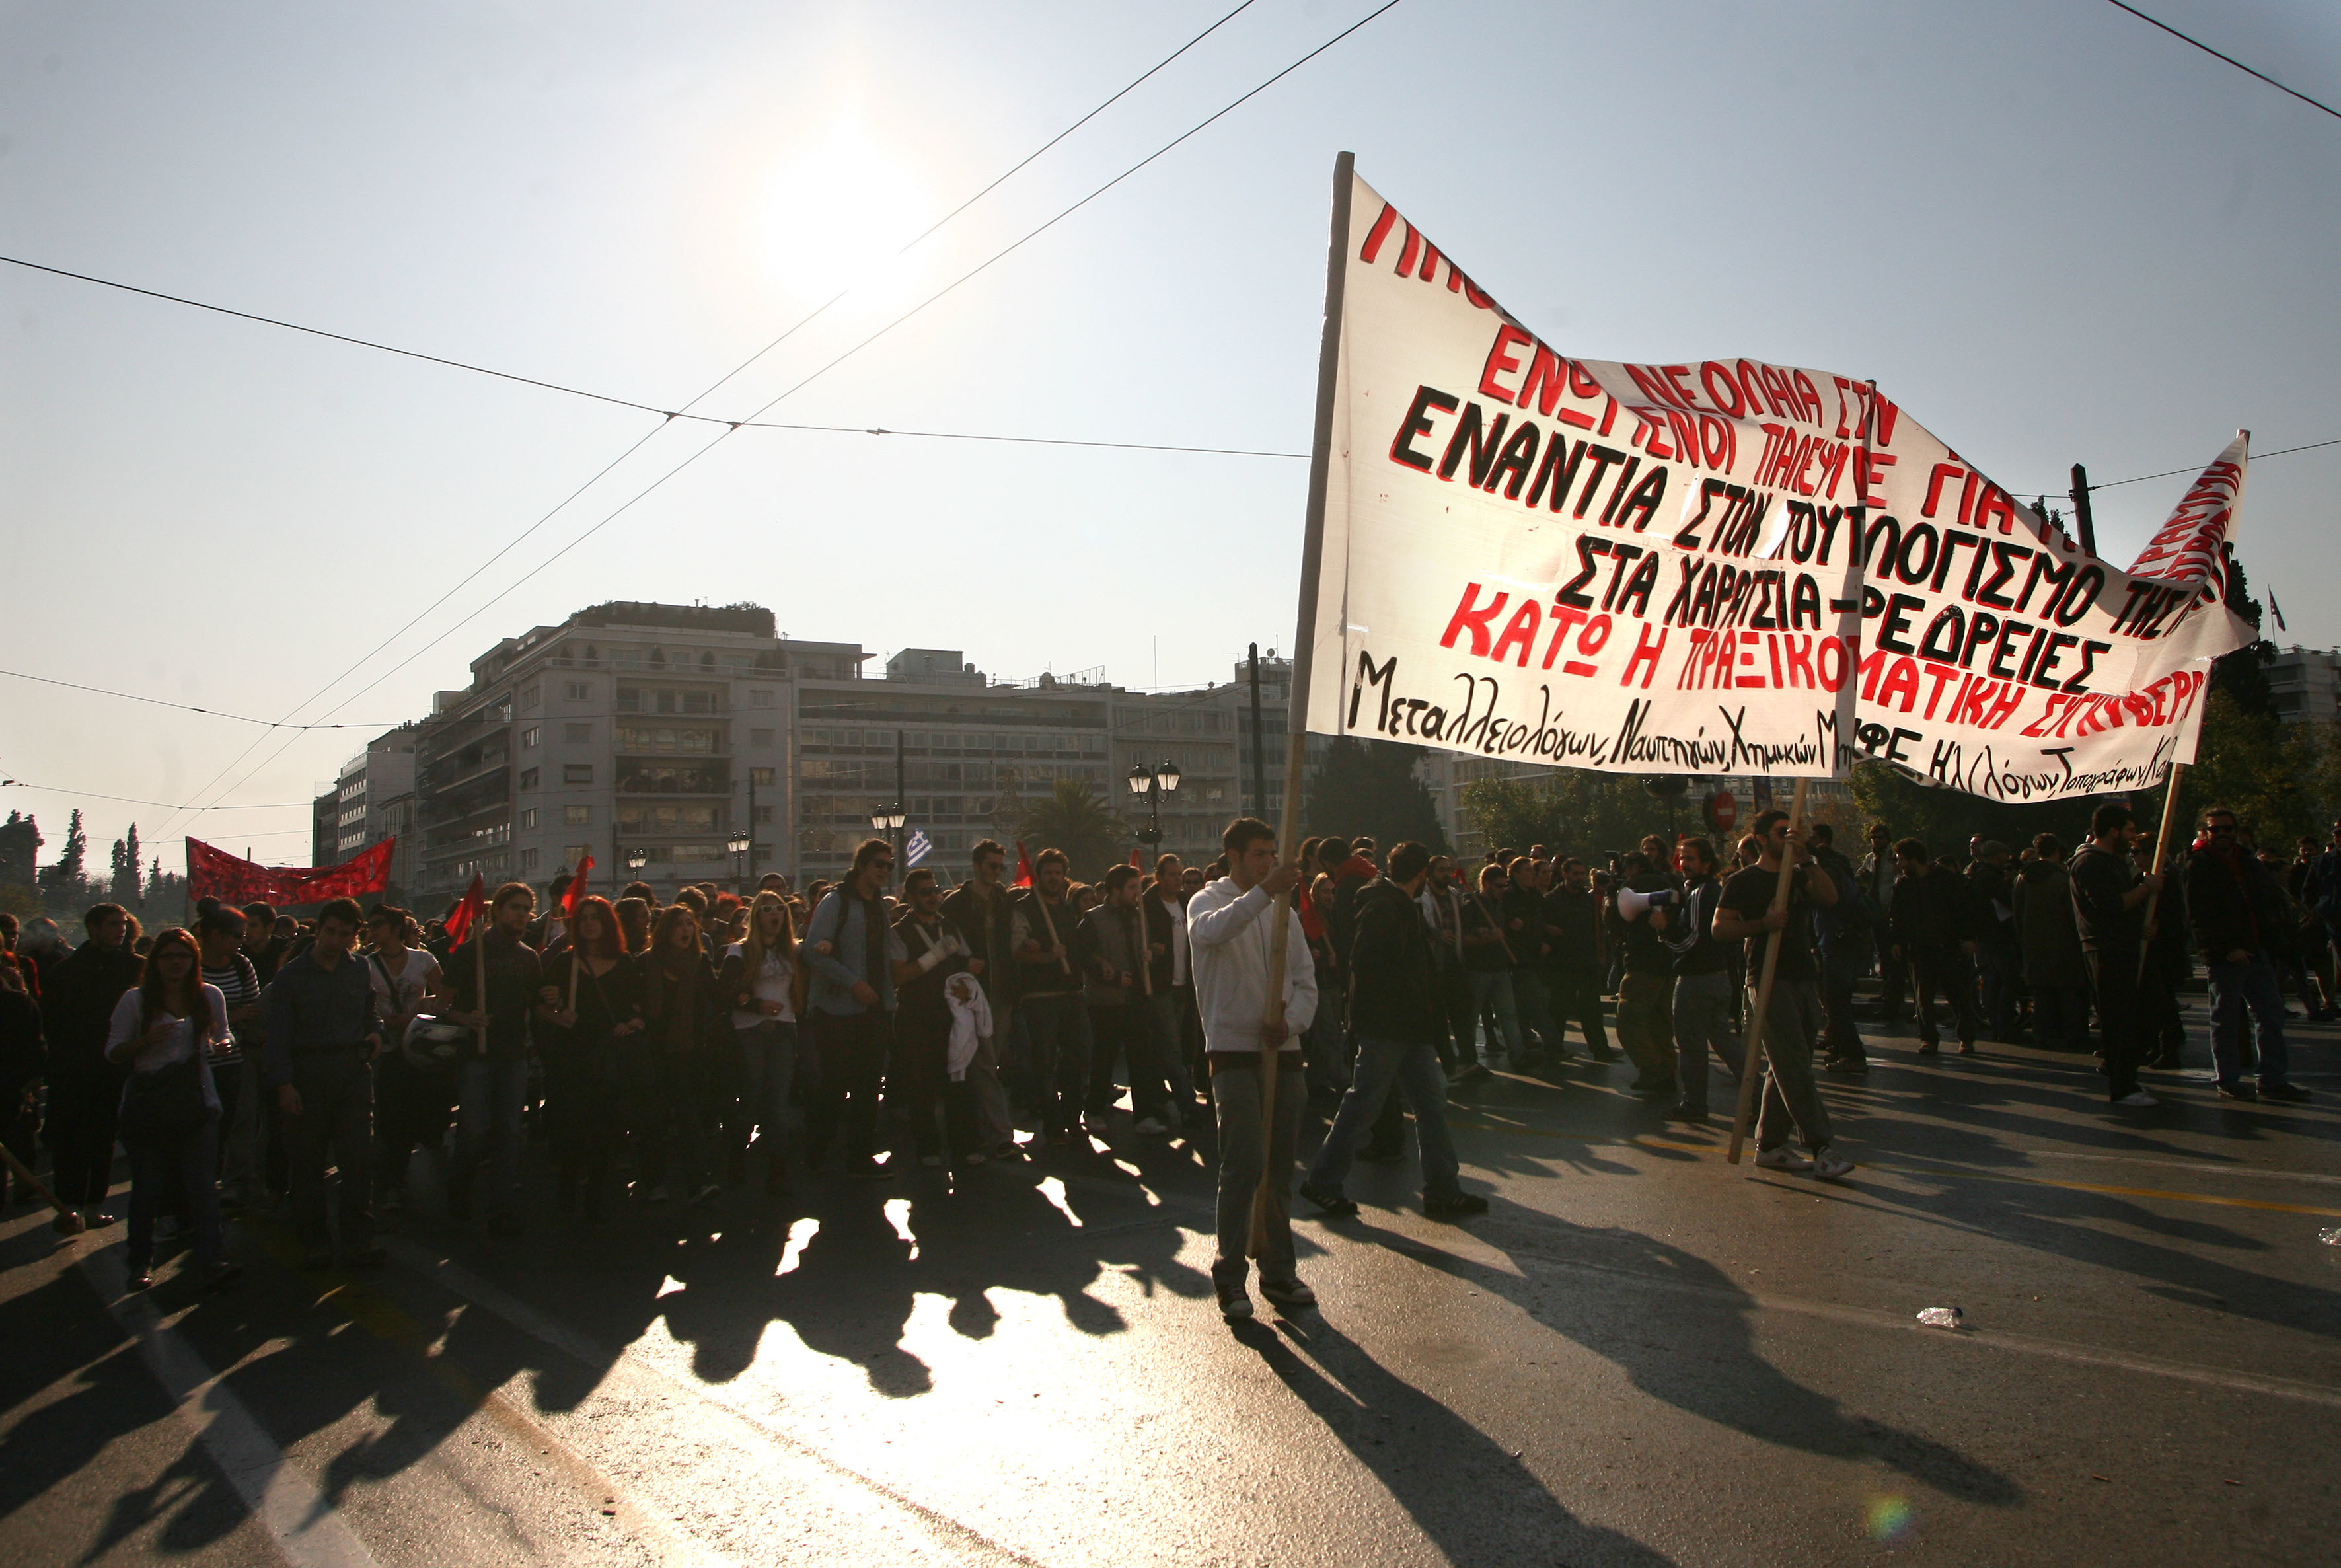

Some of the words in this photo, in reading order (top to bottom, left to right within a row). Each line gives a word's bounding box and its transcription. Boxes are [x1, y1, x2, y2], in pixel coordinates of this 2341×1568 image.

[1622, 357, 1822, 428] ΝΕΟΛΑΙΑ
[1389, 385, 1668, 533] ΕΝΑΝΤΙΑ
[1672, 478, 1773, 558] ΣΤΟΝ
[1920, 463, 2015, 535] ΓΙΑ
[1555, 532, 1666, 618] ΣΤΑ
[1440, 582, 1612, 678] ΚΑΤΩ
[1619, 622, 1667, 689] Η
